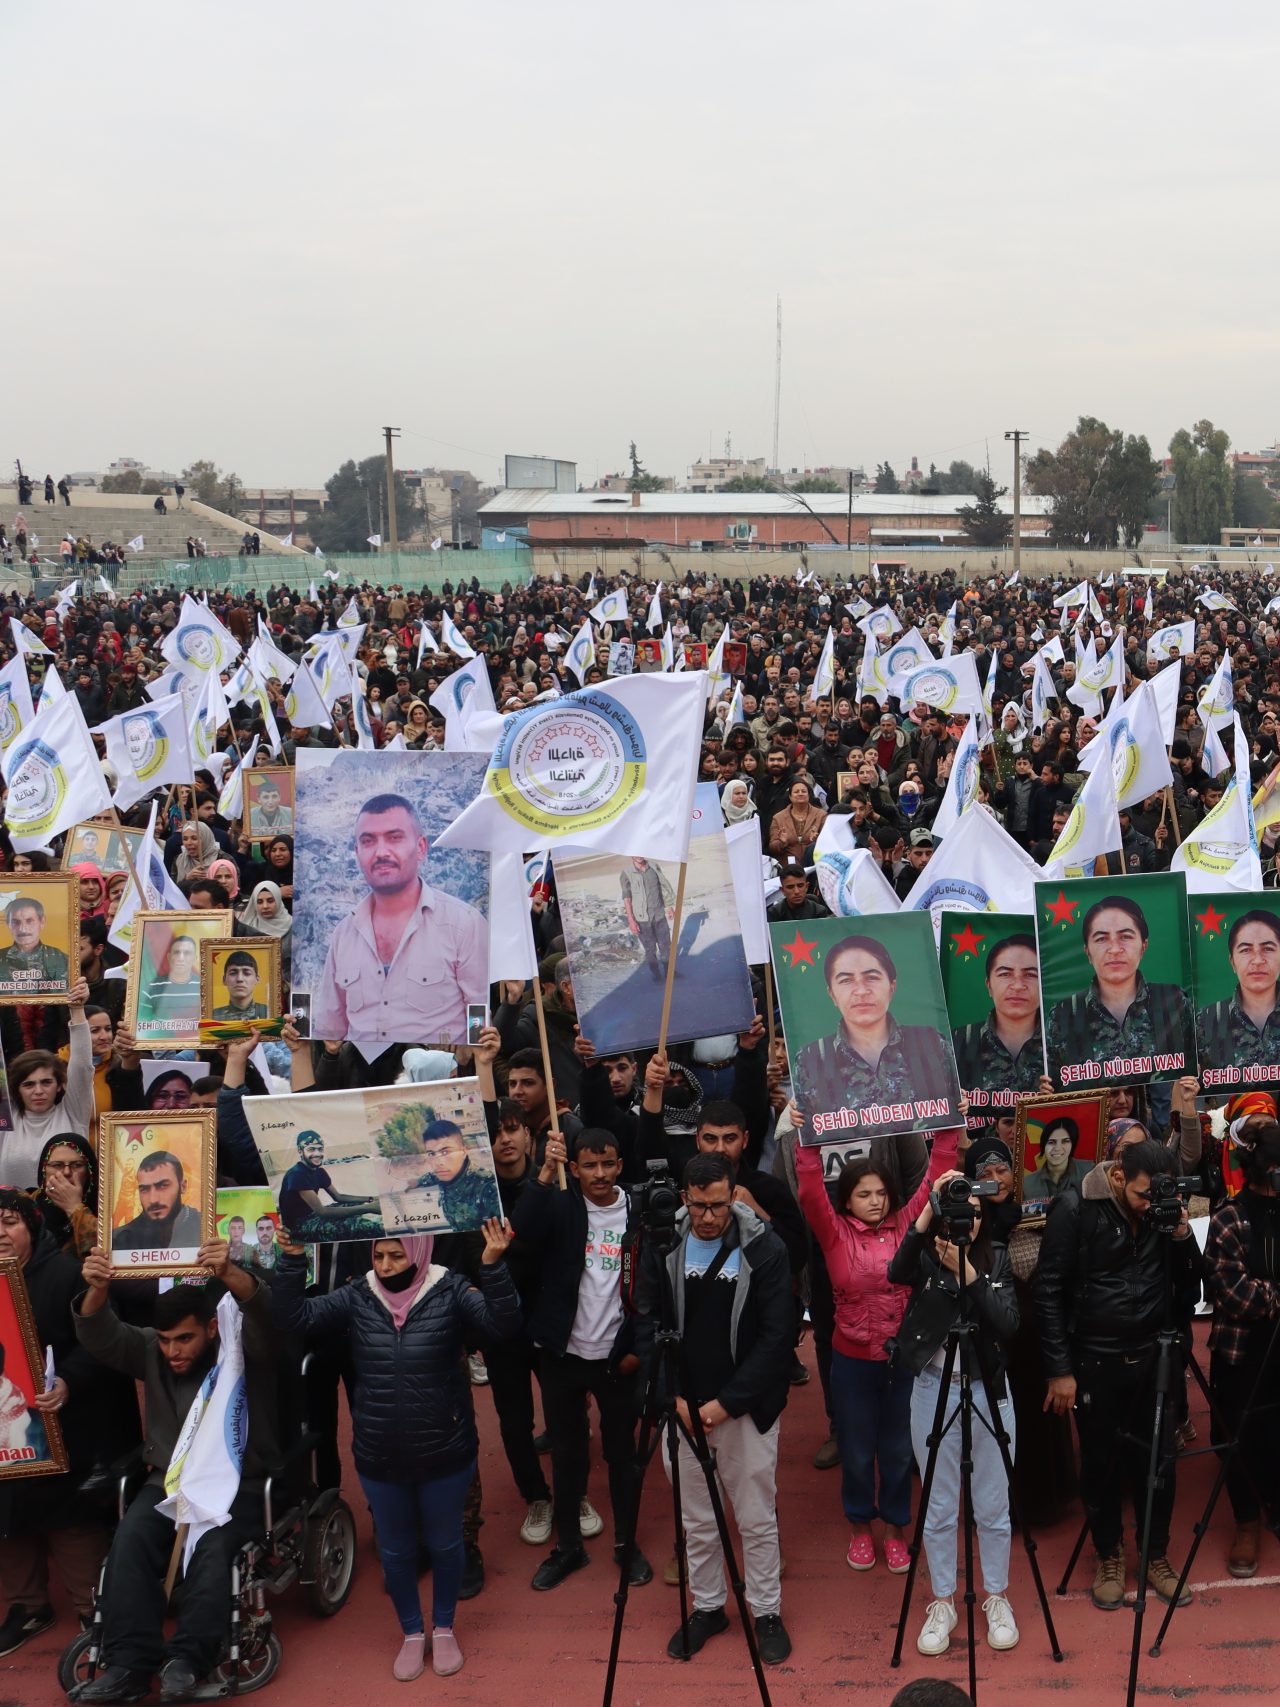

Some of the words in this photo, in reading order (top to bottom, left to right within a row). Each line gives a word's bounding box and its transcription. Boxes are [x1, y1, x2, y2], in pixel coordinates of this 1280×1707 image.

[39, 980, 67, 990] XANE
[1060, 1060, 1101, 1085] ŞEHÎD
[1103, 1056, 1152, 1078] NÛDEM
[1153, 1052, 1184, 1071] WAN
[1203, 1066, 1241, 1088] ŞEHÎD
[966, 1088, 989, 1107] HÎD
[812, 1109, 859, 1136] ŞEHÎD
[860, 1102, 914, 1126] NÛDEM
[916, 1097, 950, 1119] WAN
[131, 1144, 138, 1154] P
[145, 1129, 153, 1141] G
[130, 1250, 181, 1264] Ş.HEMO
